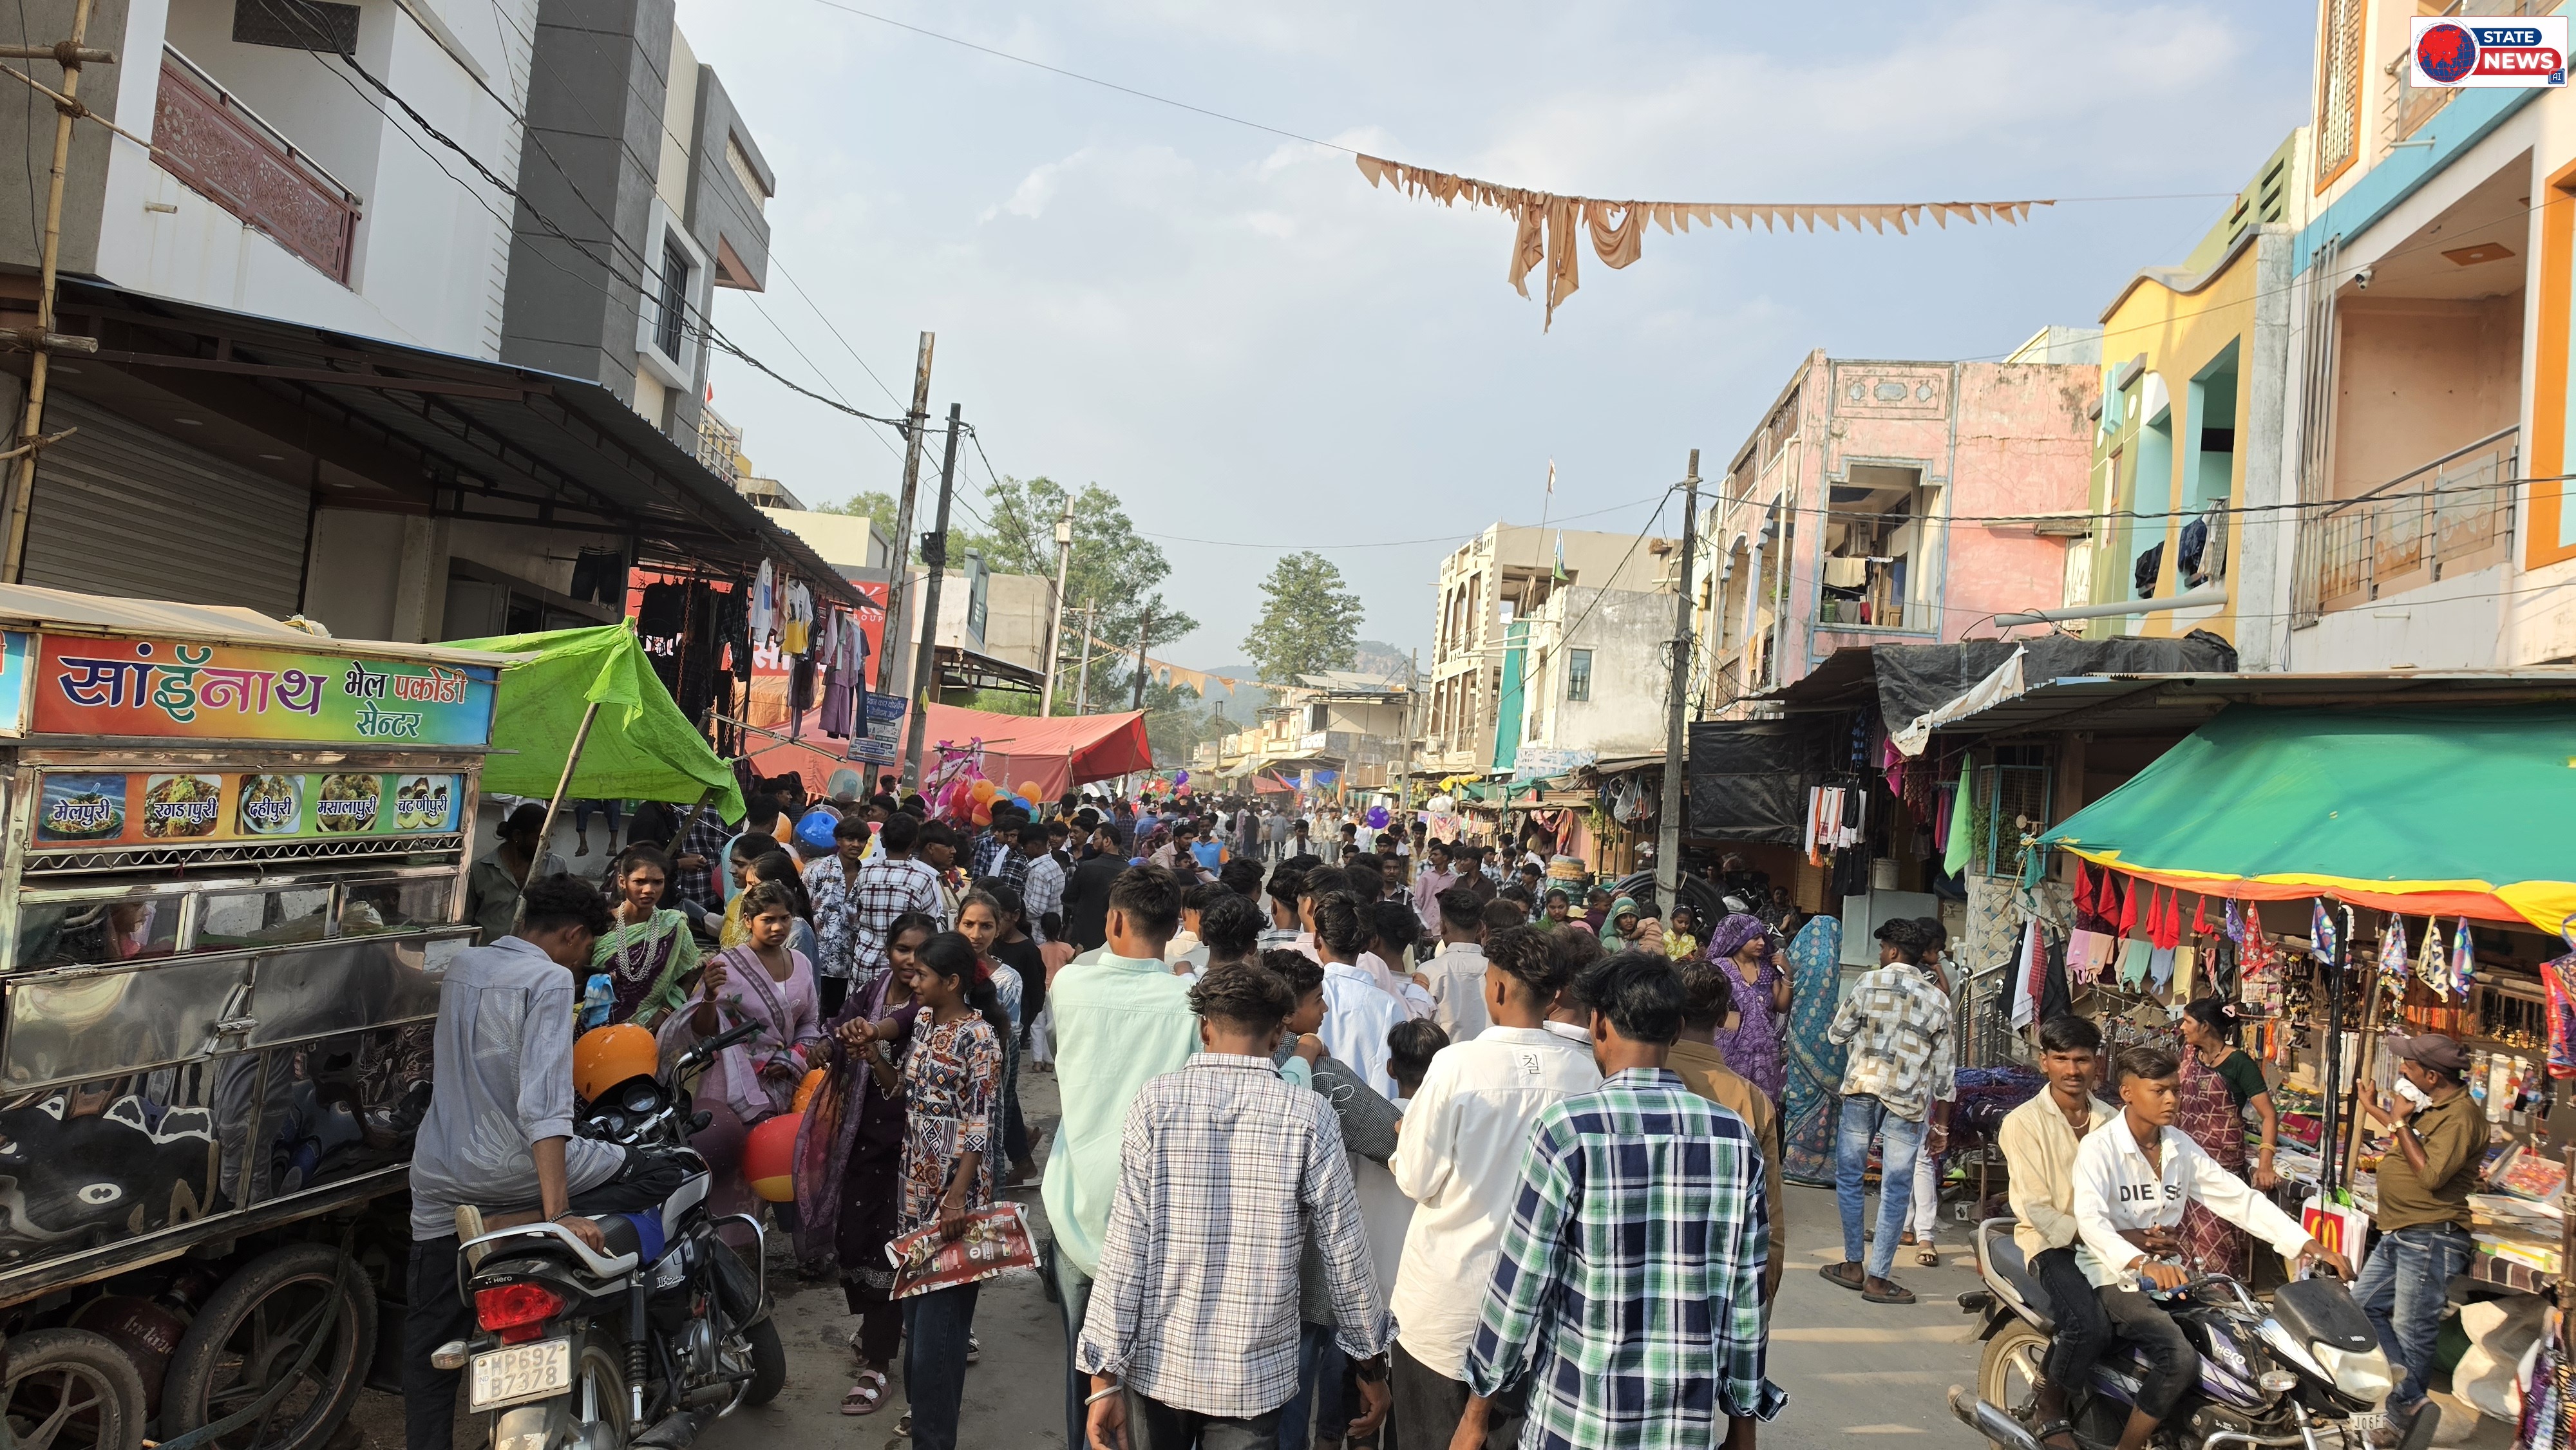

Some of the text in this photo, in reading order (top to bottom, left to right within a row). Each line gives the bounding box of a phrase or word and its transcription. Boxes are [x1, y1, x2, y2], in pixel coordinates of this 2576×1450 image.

[853, 614, 884, 623] ROUP
[343, 659, 389, 699] भेल
[355, 699, 422, 737] सेन्टर
[249, 796, 293, 822] दहीपुरी
[317, 794, 377, 820] मसालापुरी
[1522, 1053, 1541, 1074] 칠
[491, 1366, 558, 1398] B7378
